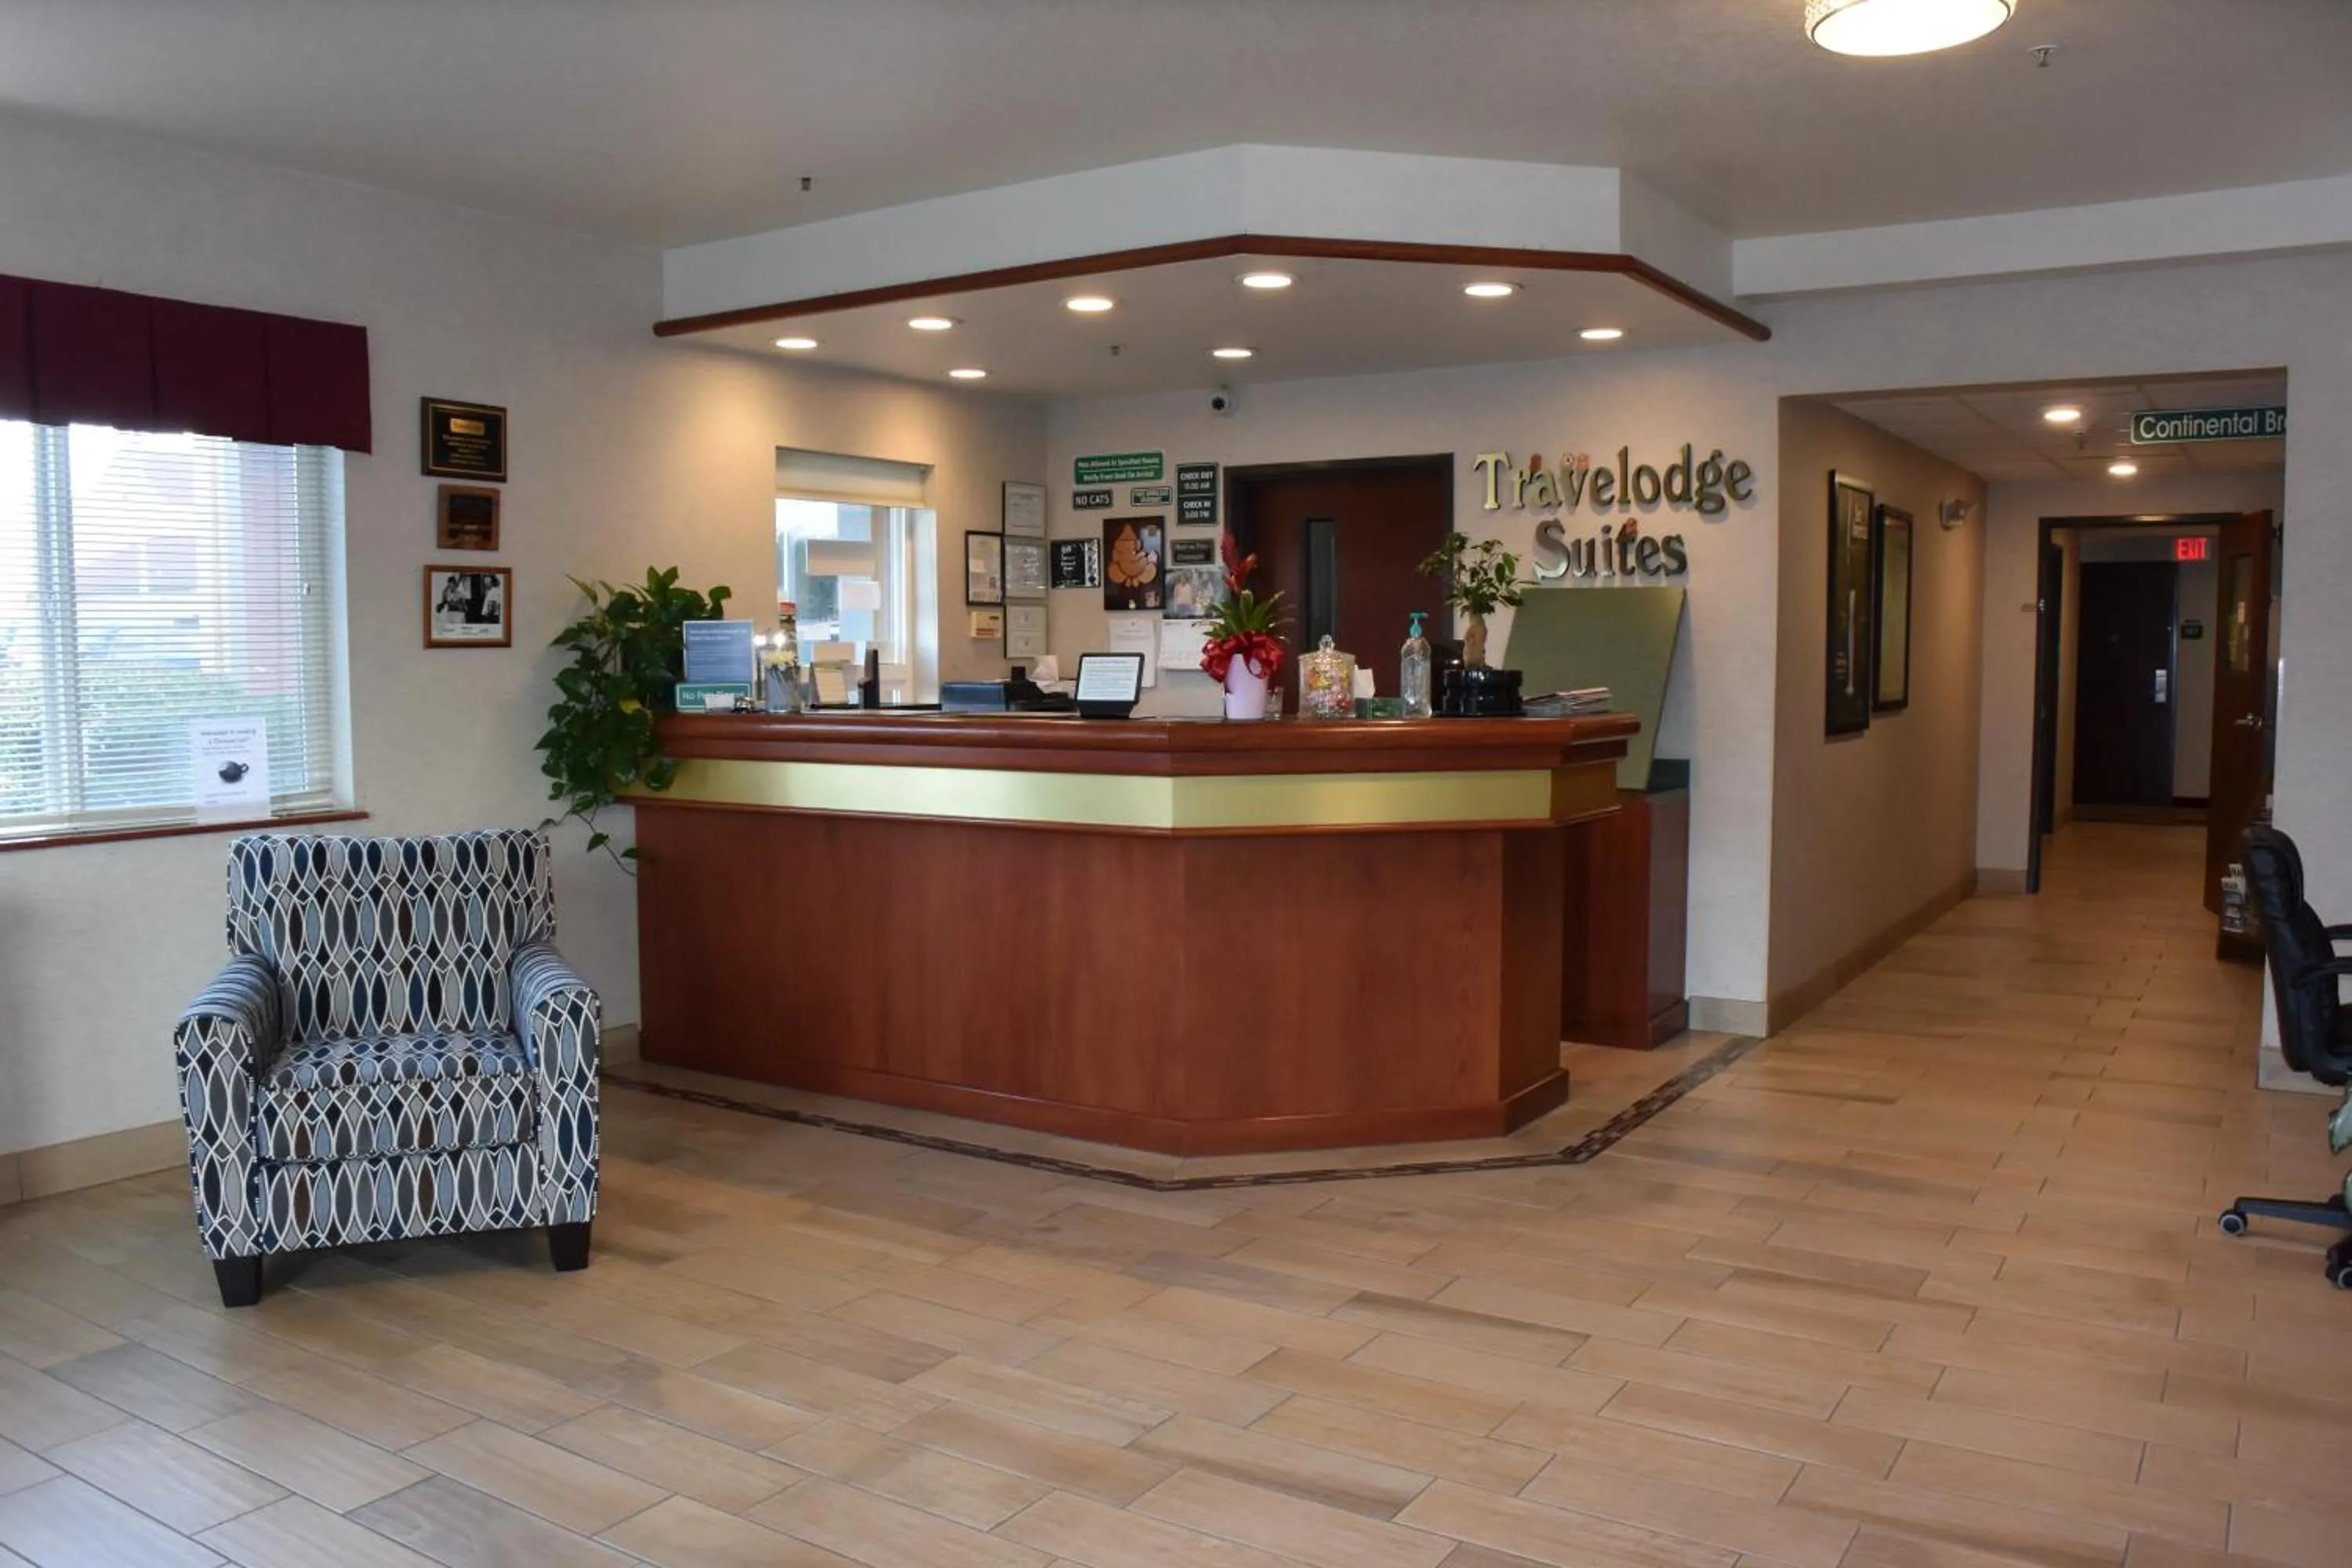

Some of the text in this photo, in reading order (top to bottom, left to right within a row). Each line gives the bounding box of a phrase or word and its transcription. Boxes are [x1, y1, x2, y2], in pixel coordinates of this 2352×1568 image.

[2140, 410, 2287, 438] Continental Br
[1180, 470, 1214, 481] CHECK OUT
[1472, 442, 1754, 514] Travelodge
[1075, 494, 1109, 505] NO CATS
[1533, 517, 1688, 581] Suites
[2177, 538, 2207, 559] EXIT
